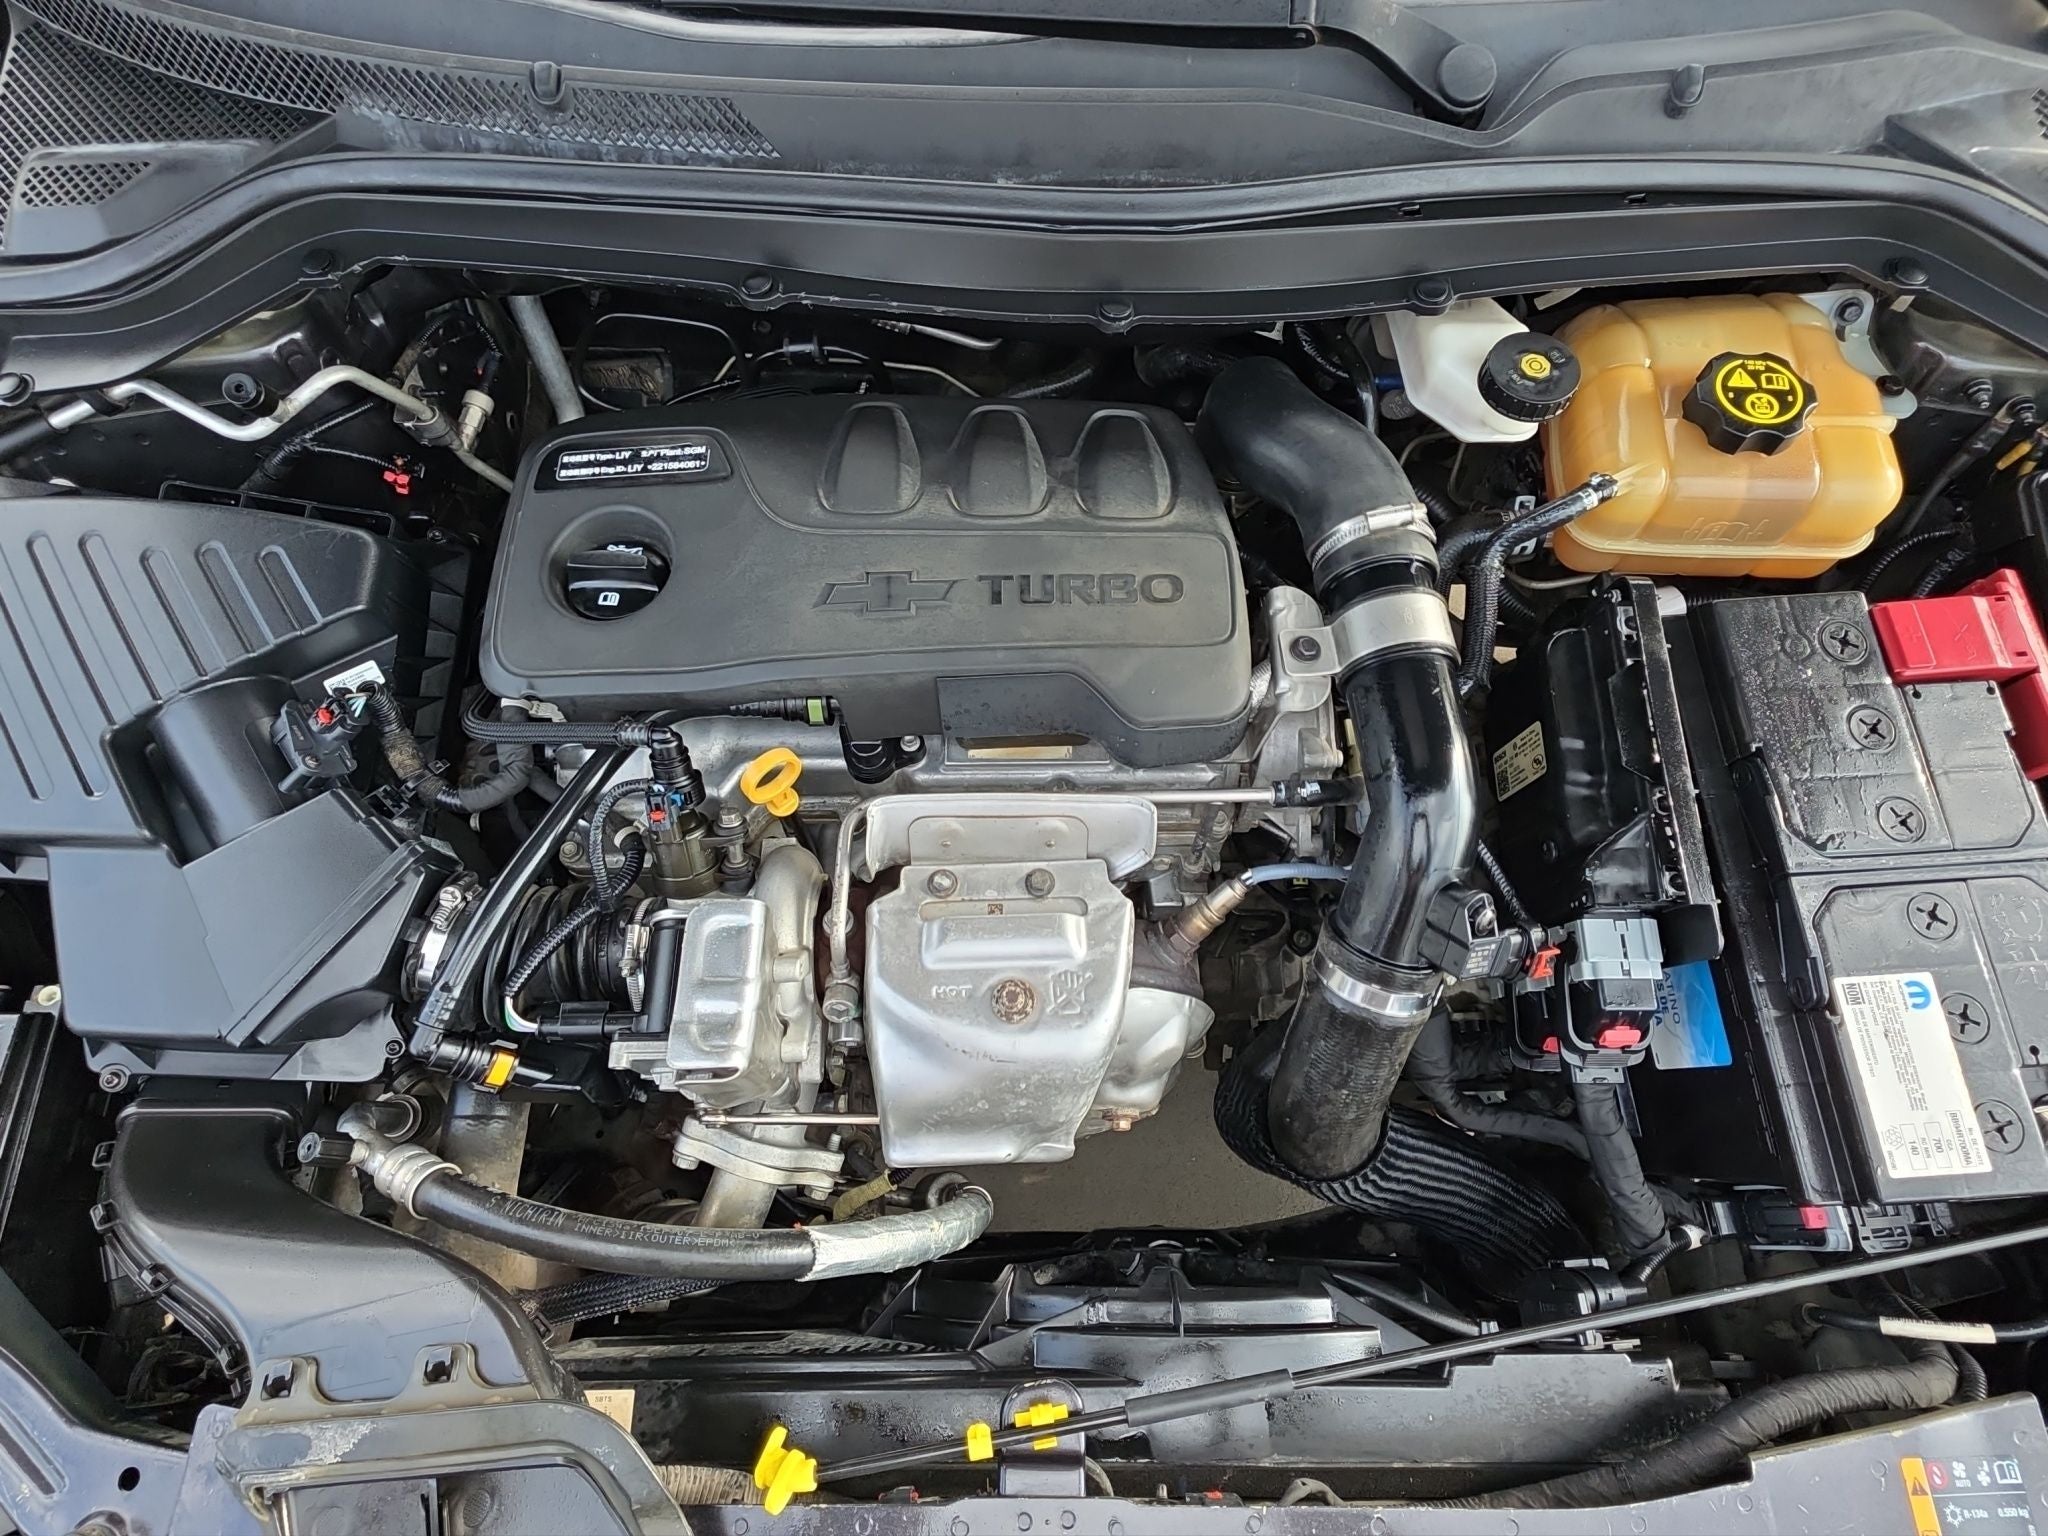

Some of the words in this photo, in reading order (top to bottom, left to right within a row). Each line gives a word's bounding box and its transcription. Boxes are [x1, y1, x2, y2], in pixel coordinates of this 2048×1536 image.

[683, 446, 706, 455] SGM
[978, 574, 1184, 605] TURBO
[931, 985, 973, 999] HOT
[1663, 971, 1681, 1024] ATINO
[1843, 982, 1862, 1005] NOM
[1907, 1140, 1920, 1155] 140
[1931, 1137, 1945, 1153] 700
[501, 1198, 568, 1228] NICHIRIN
